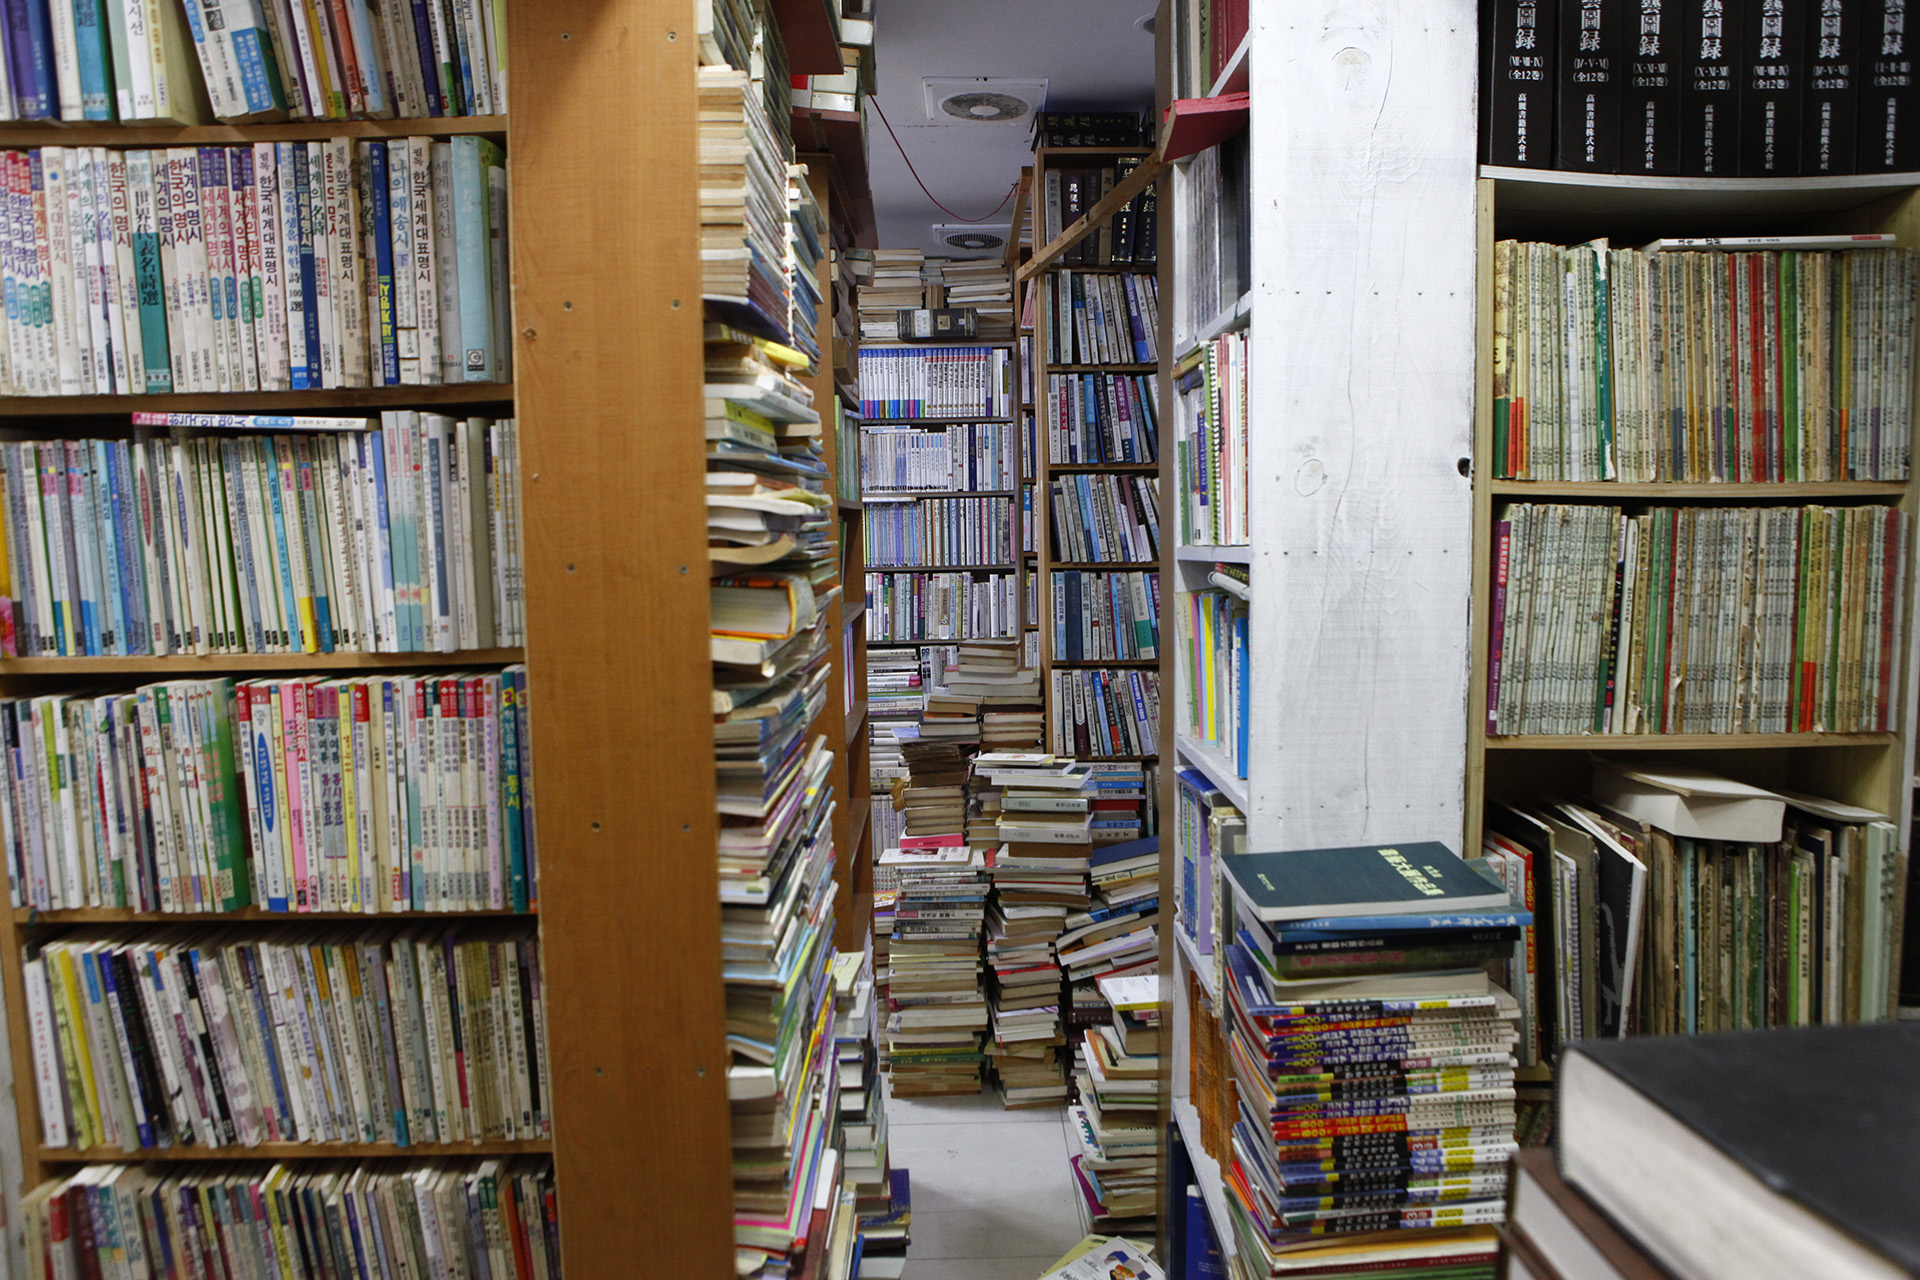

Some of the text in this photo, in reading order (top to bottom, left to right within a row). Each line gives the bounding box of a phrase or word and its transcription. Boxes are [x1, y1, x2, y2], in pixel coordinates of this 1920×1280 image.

[110, 161, 132, 248] 한국의 명시
[155, 163, 175, 249] 세계의 명시
[168, 159, 191, 245] 한국의 명시
[183, 156, 203, 243] 세계의 명시
[391, 159, 408, 194] 나의
[135, 191, 160, 306] 世界代表名詩選
[202, 188, 221, 273] 세계의 명시
[217, 187, 235, 273] 세계의 명시
[244, 187, 262, 272] 세계의 명시
[259, 175, 278, 287] 한국세계대표명시
[335, 170, 354, 282] 한국세계대표명시
[392, 196, 410, 249] 애송시
[413, 172, 432, 282] 한국세계대표명시
[504, 691, 513, 703] 2
[508, 774, 520, 810] 동시
